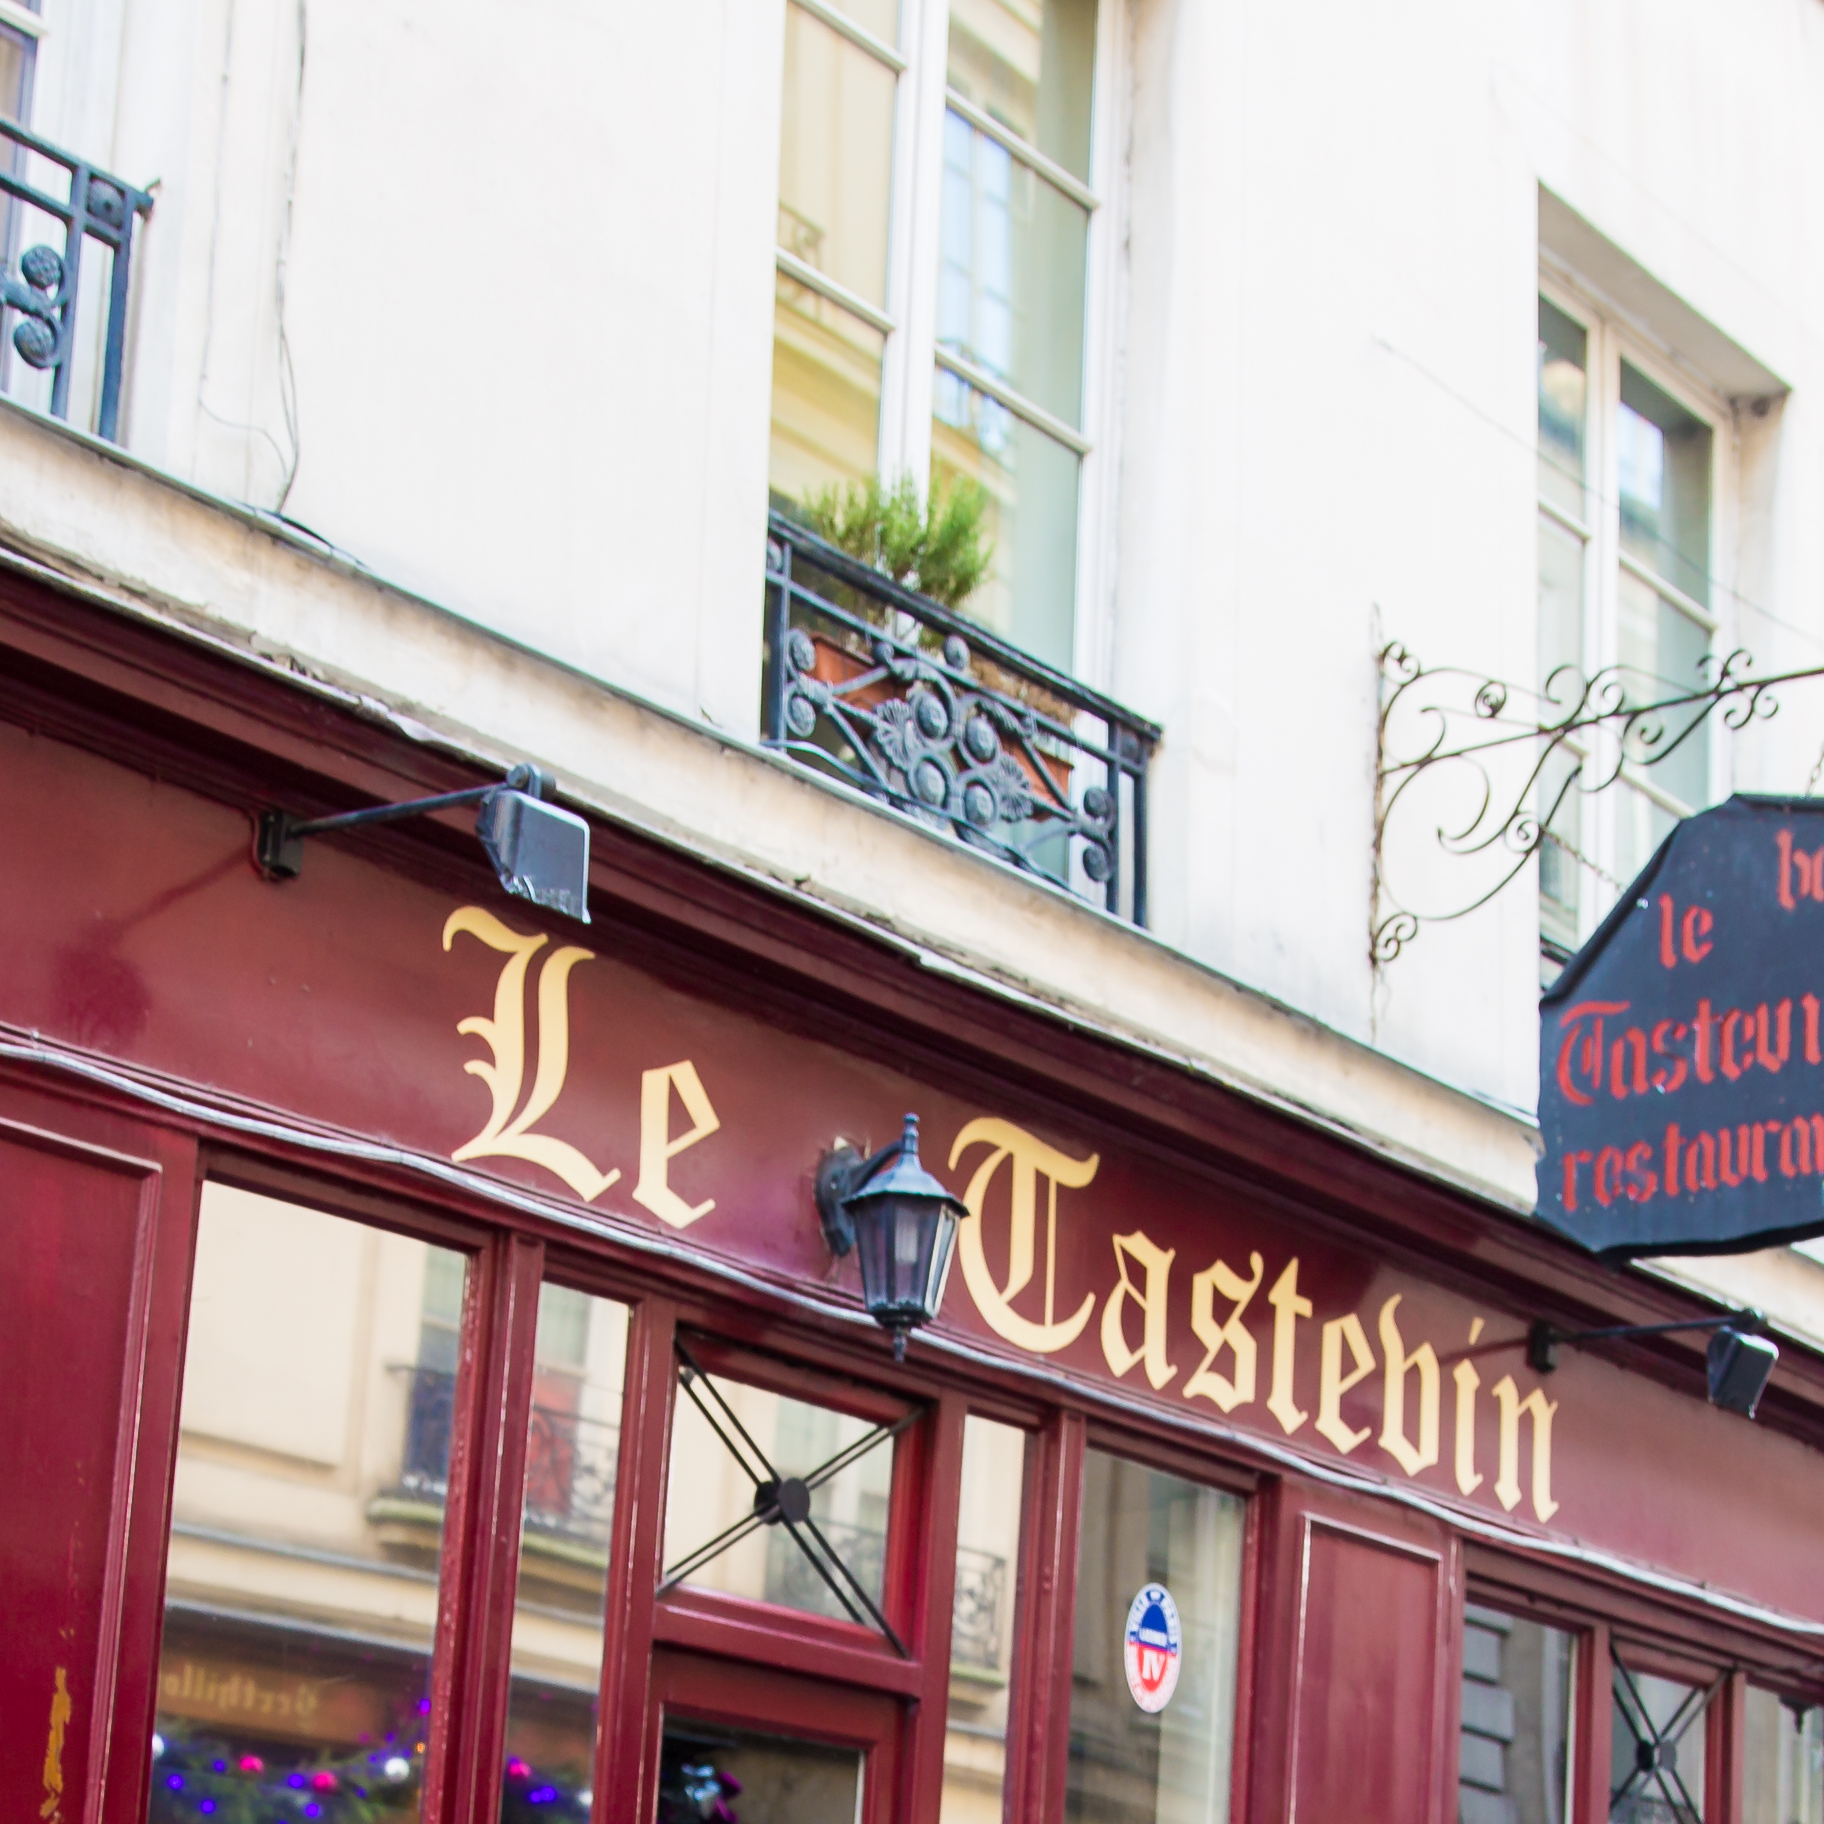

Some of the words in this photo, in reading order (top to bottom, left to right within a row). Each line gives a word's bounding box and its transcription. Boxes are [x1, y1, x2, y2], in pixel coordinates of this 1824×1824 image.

[1659, 893, 1715, 970] le
[442, 904, 722, 1230] Le
[947, 1116, 1560, 1524] Tastevin
